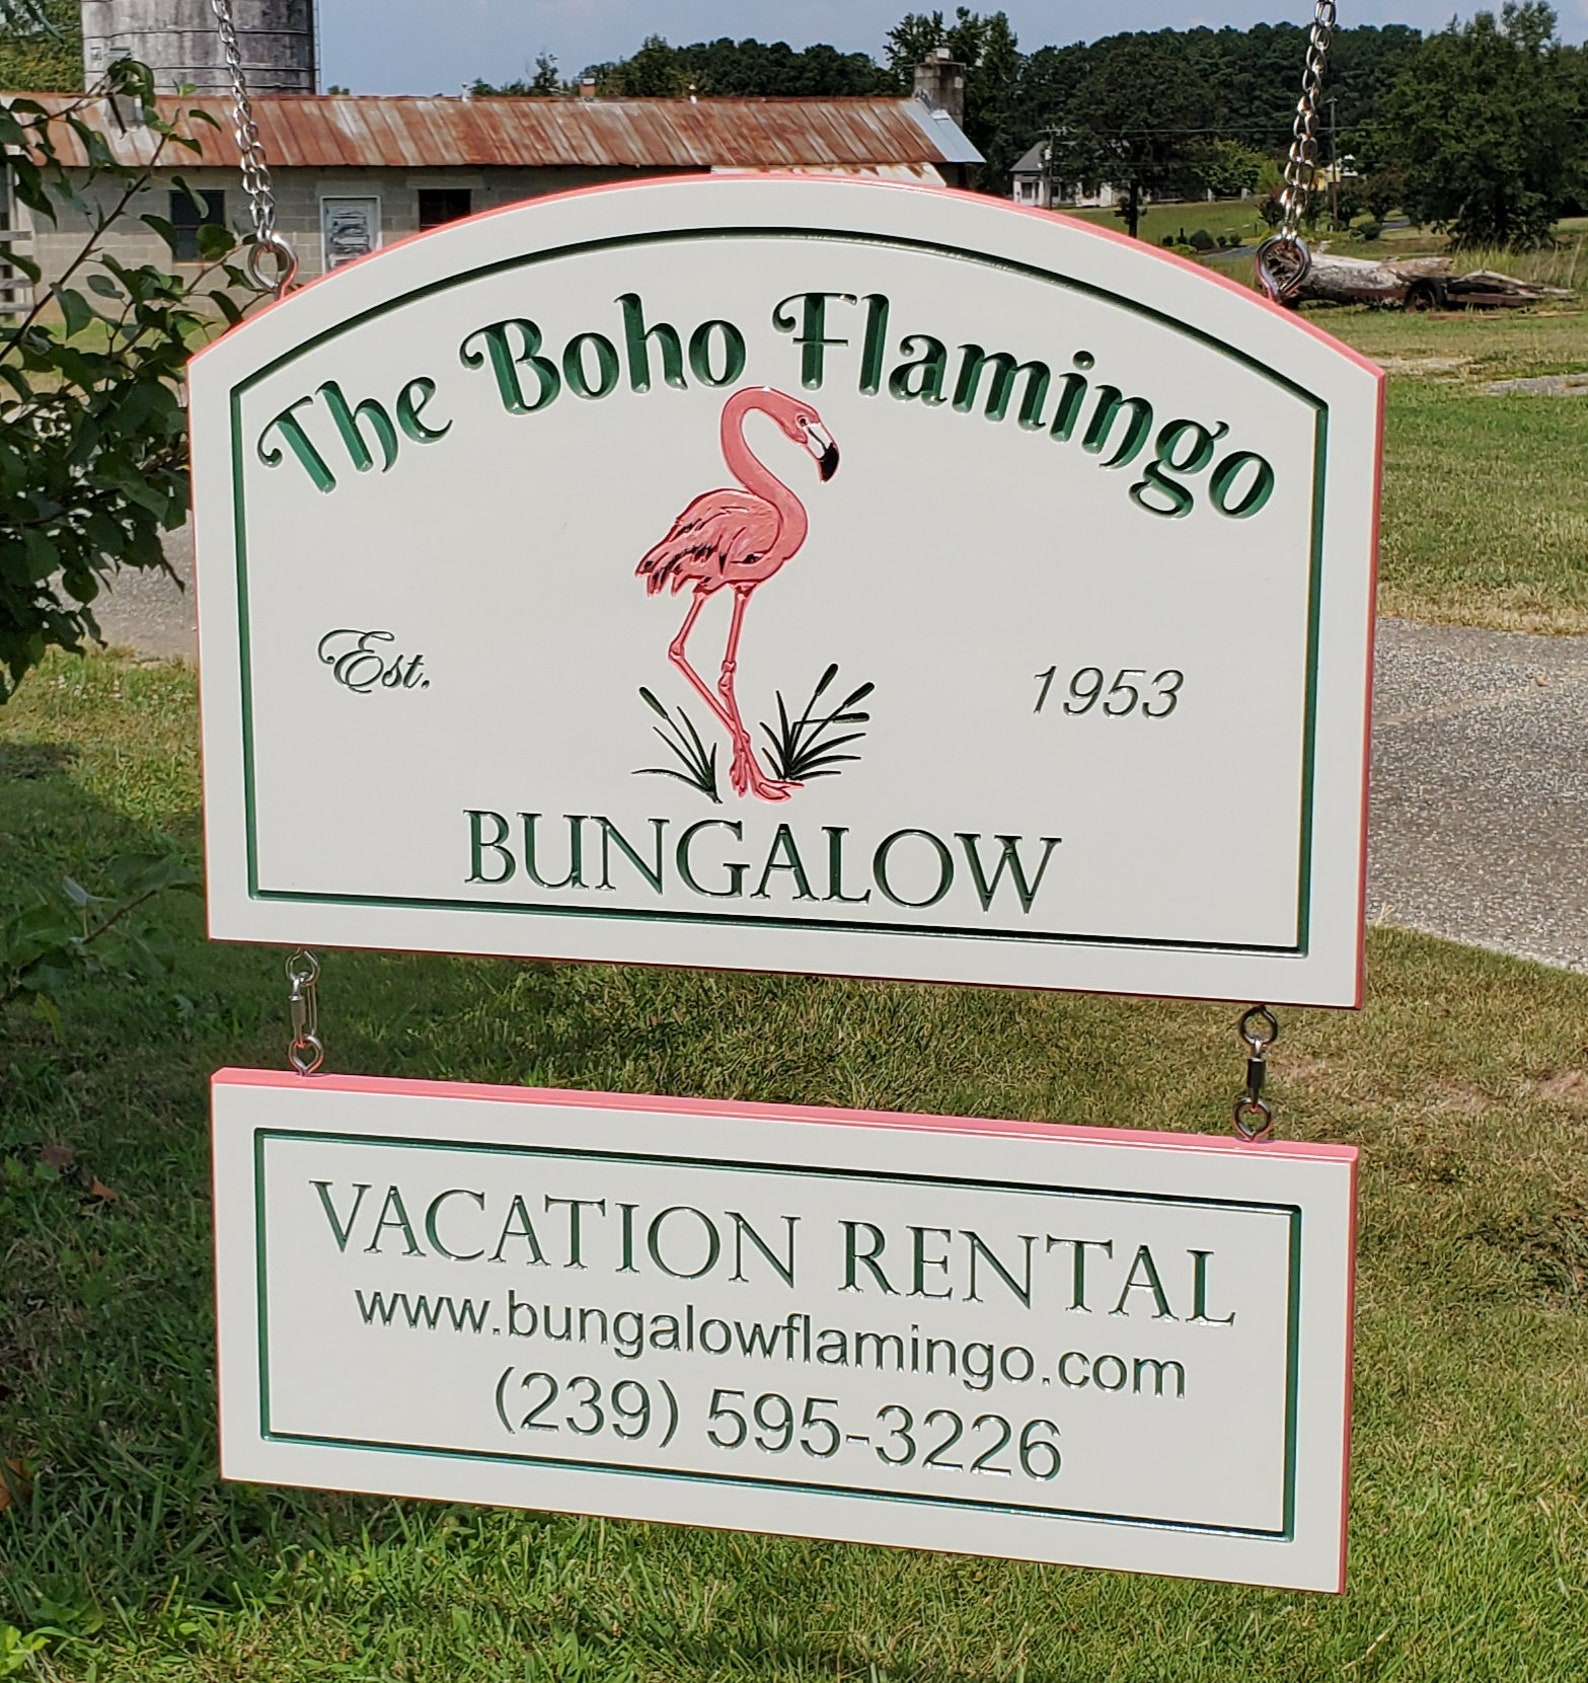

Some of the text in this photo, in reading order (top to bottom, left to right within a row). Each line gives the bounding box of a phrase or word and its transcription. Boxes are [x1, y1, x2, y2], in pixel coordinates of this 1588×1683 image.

[257, 292, 1275, 519] The Boho Flamingo
[318, 629, 1184, 719] Est. 1953
[463, 810, 1062, 916] BUNGALOW
[309, 1180, 1236, 1327] VACATION RENTAL
[355, 1290, 1185, 1398] www.bungalowflamingo.com
[496, 1367, 1061, 1481] (239) 595-3226
